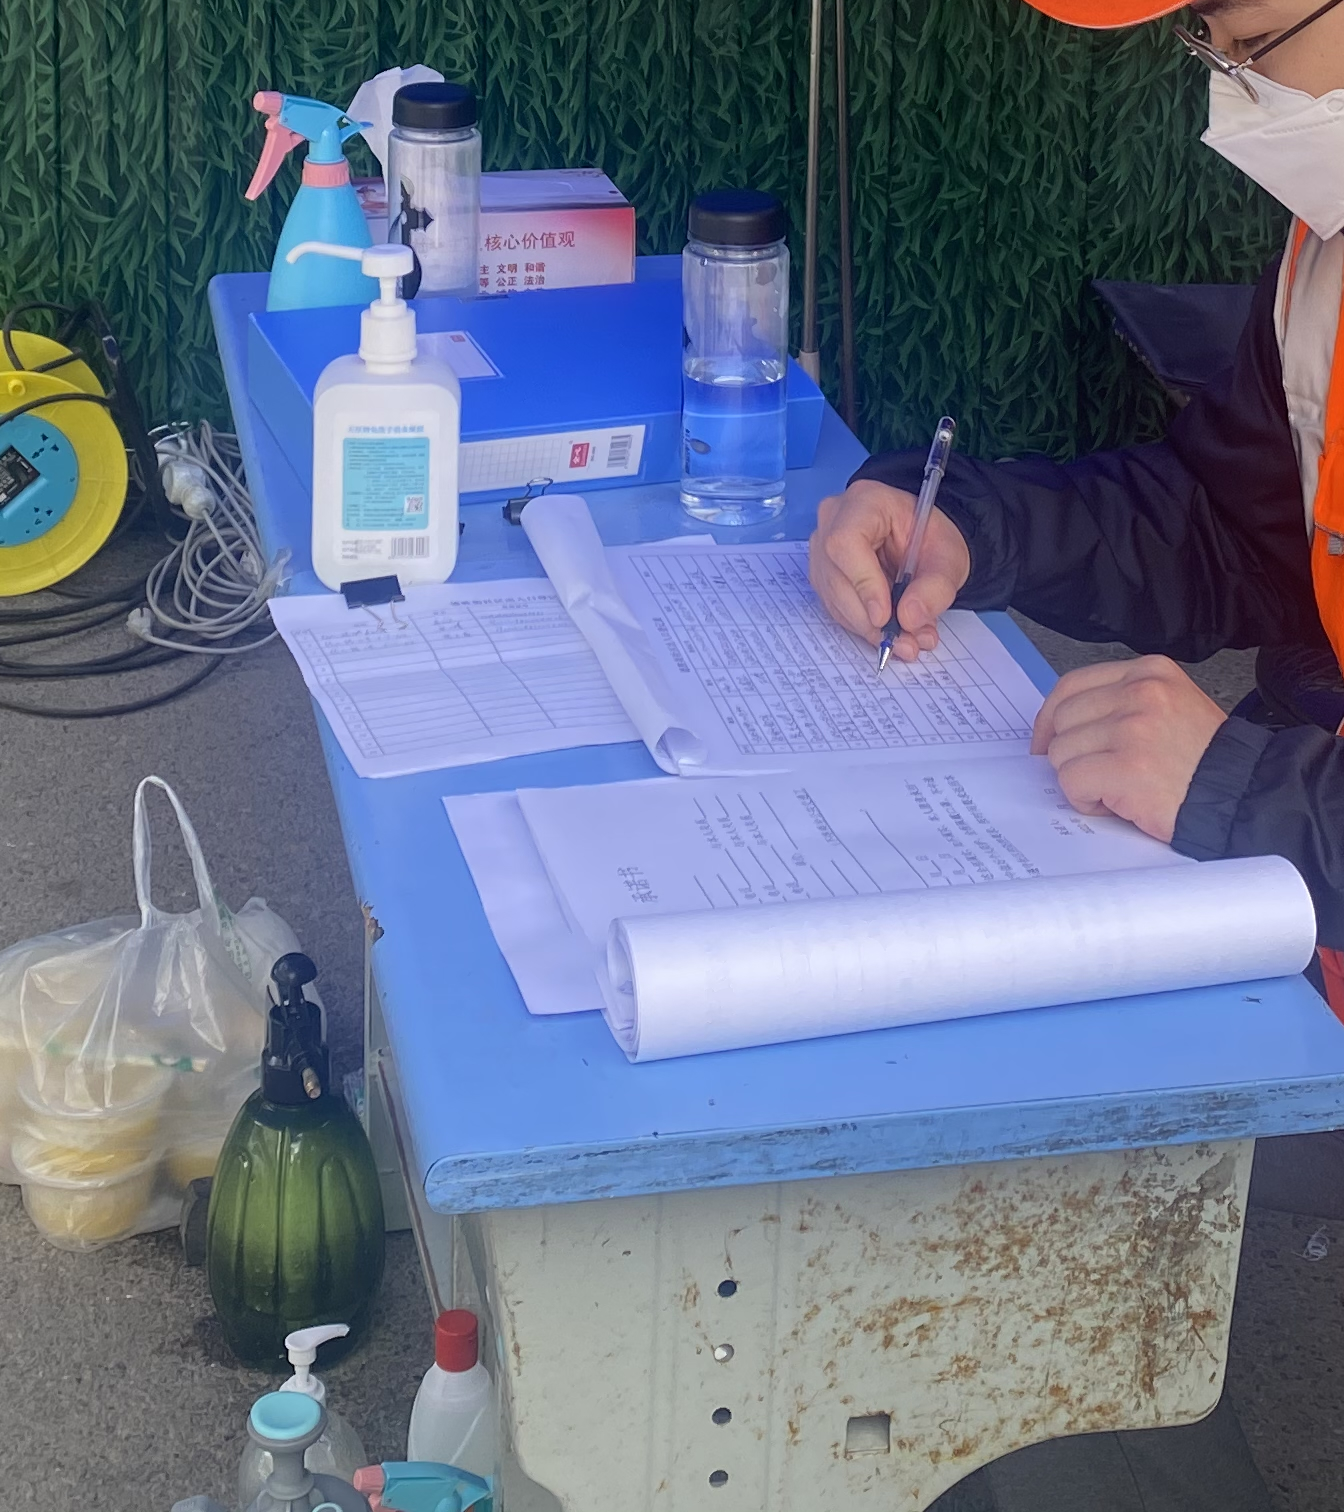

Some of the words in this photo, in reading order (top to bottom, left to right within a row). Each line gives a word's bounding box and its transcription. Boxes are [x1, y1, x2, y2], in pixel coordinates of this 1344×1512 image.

[484, 231, 575, 251] 核心价值观
[496, 263, 518, 274] 文明
[496, 276, 517, 287] 公正
[524, 275, 545, 286] 法治
